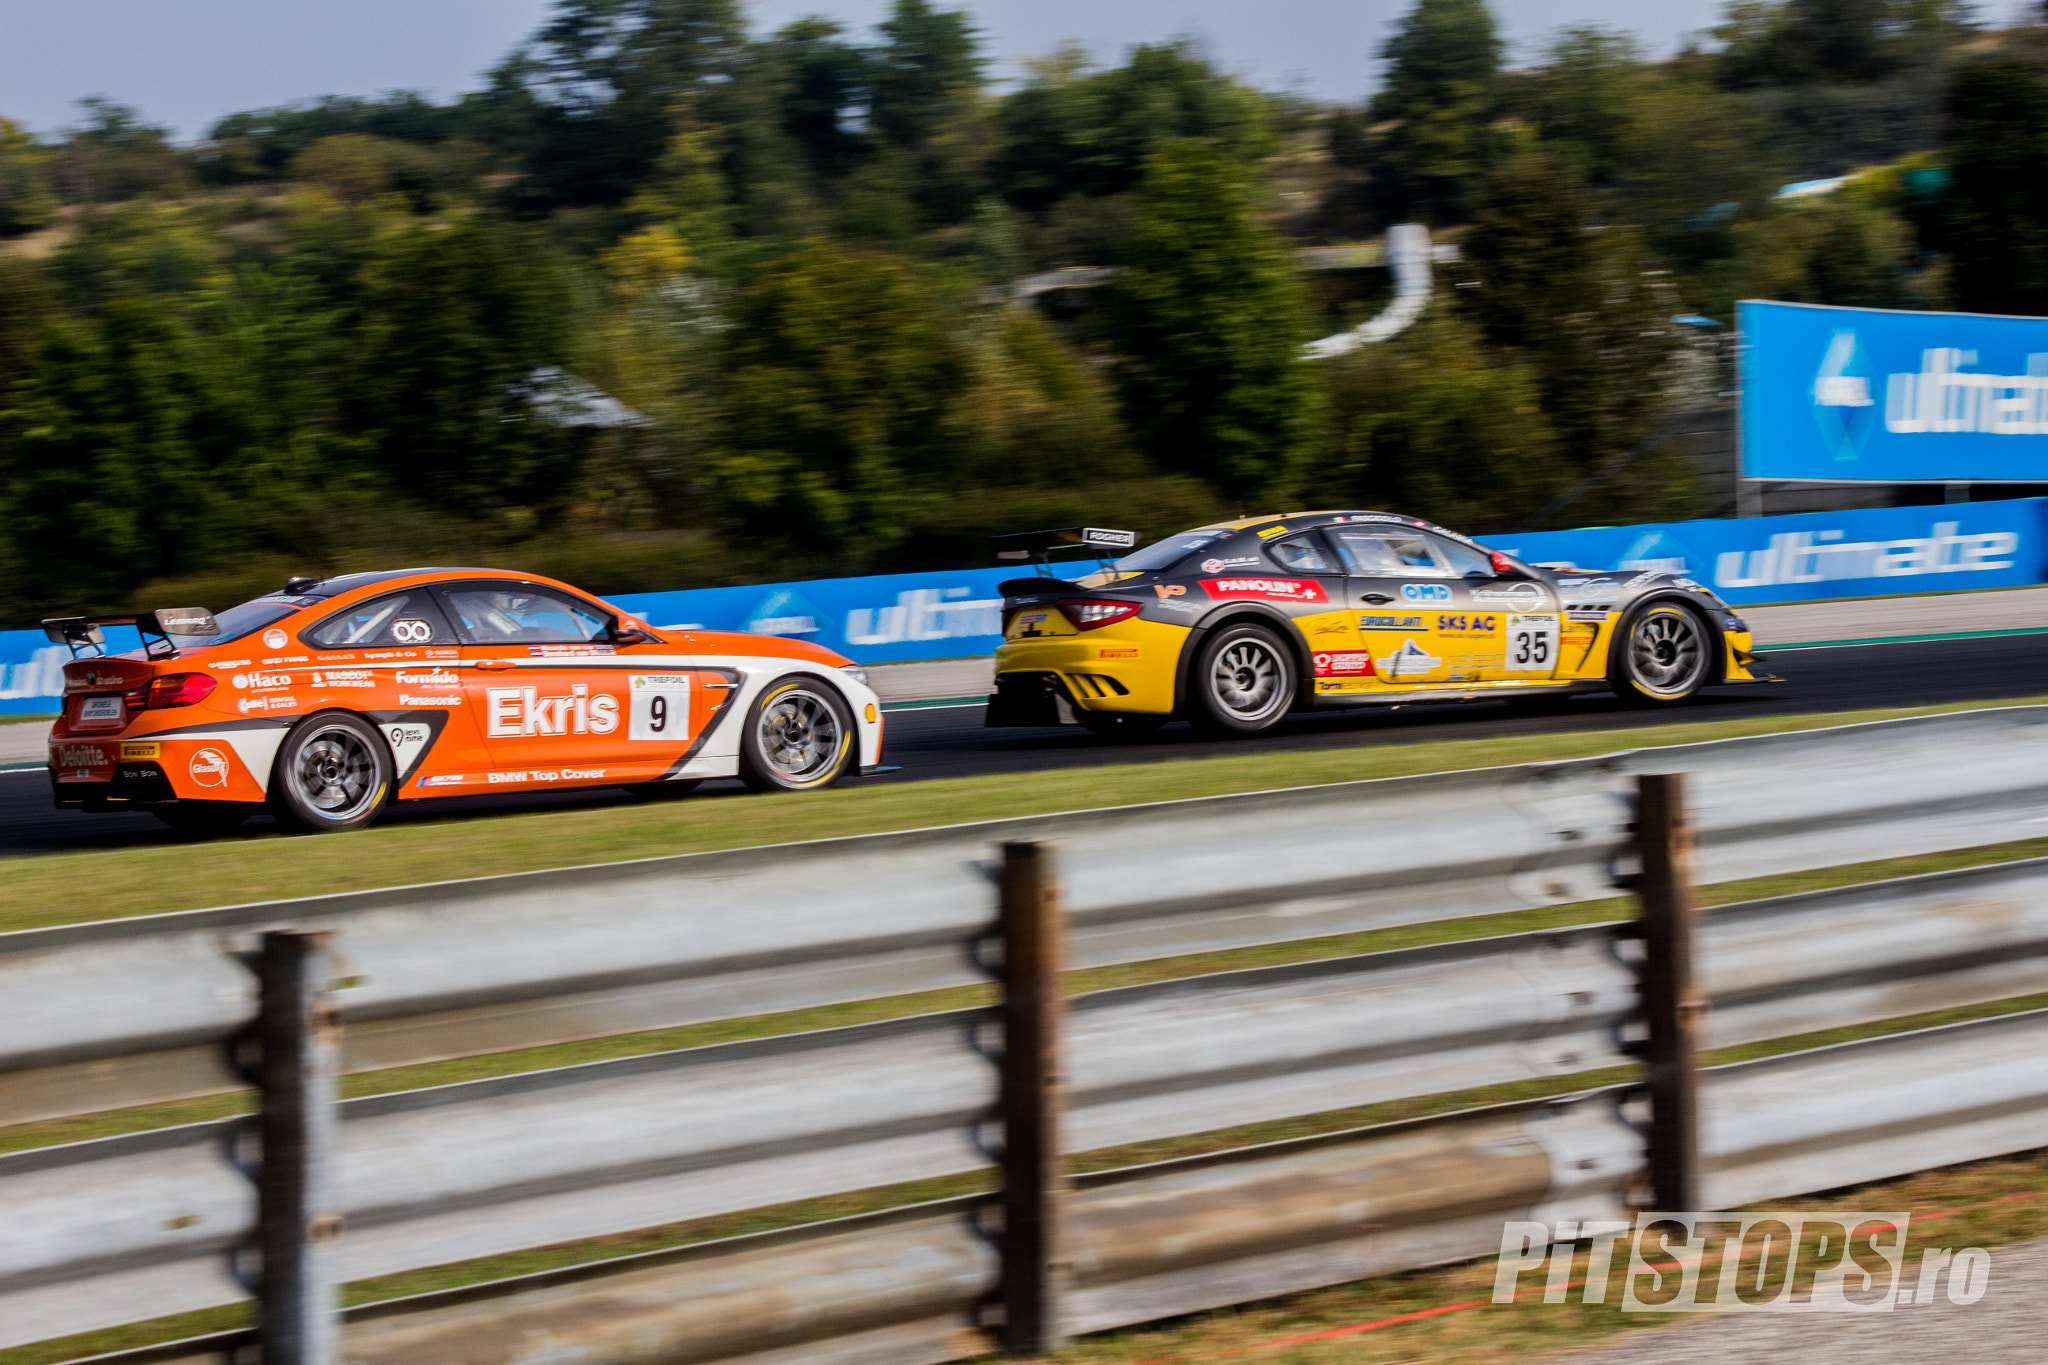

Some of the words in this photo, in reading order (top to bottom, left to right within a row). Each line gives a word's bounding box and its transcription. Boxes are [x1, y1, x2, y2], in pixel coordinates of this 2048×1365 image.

[1884, 347, 2048, 435] ultimat
[1714, 521, 2019, 588] ultimate
[1216, 580, 1295, 593] PANOLIN
[1438, 615, 1466, 630] SKS
[1471, 616, 1496, 631] AG
[1515, 631, 1548, 664] 35
[247, 673, 292, 688] Haco
[396, 667, 459, 684] Formido
[648, 676, 685, 684] TREFOIL
[399, 694, 461, 706] Panasonic
[486, 684, 620, 738] Ekris
[649, 695, 667, 732] 9
[123, 745, 156, 757] PIRELLI
[488, 772, 527, 784] BMW
[529, 770, 558, 783] Top
[560, 768, 606, 780] Cover
